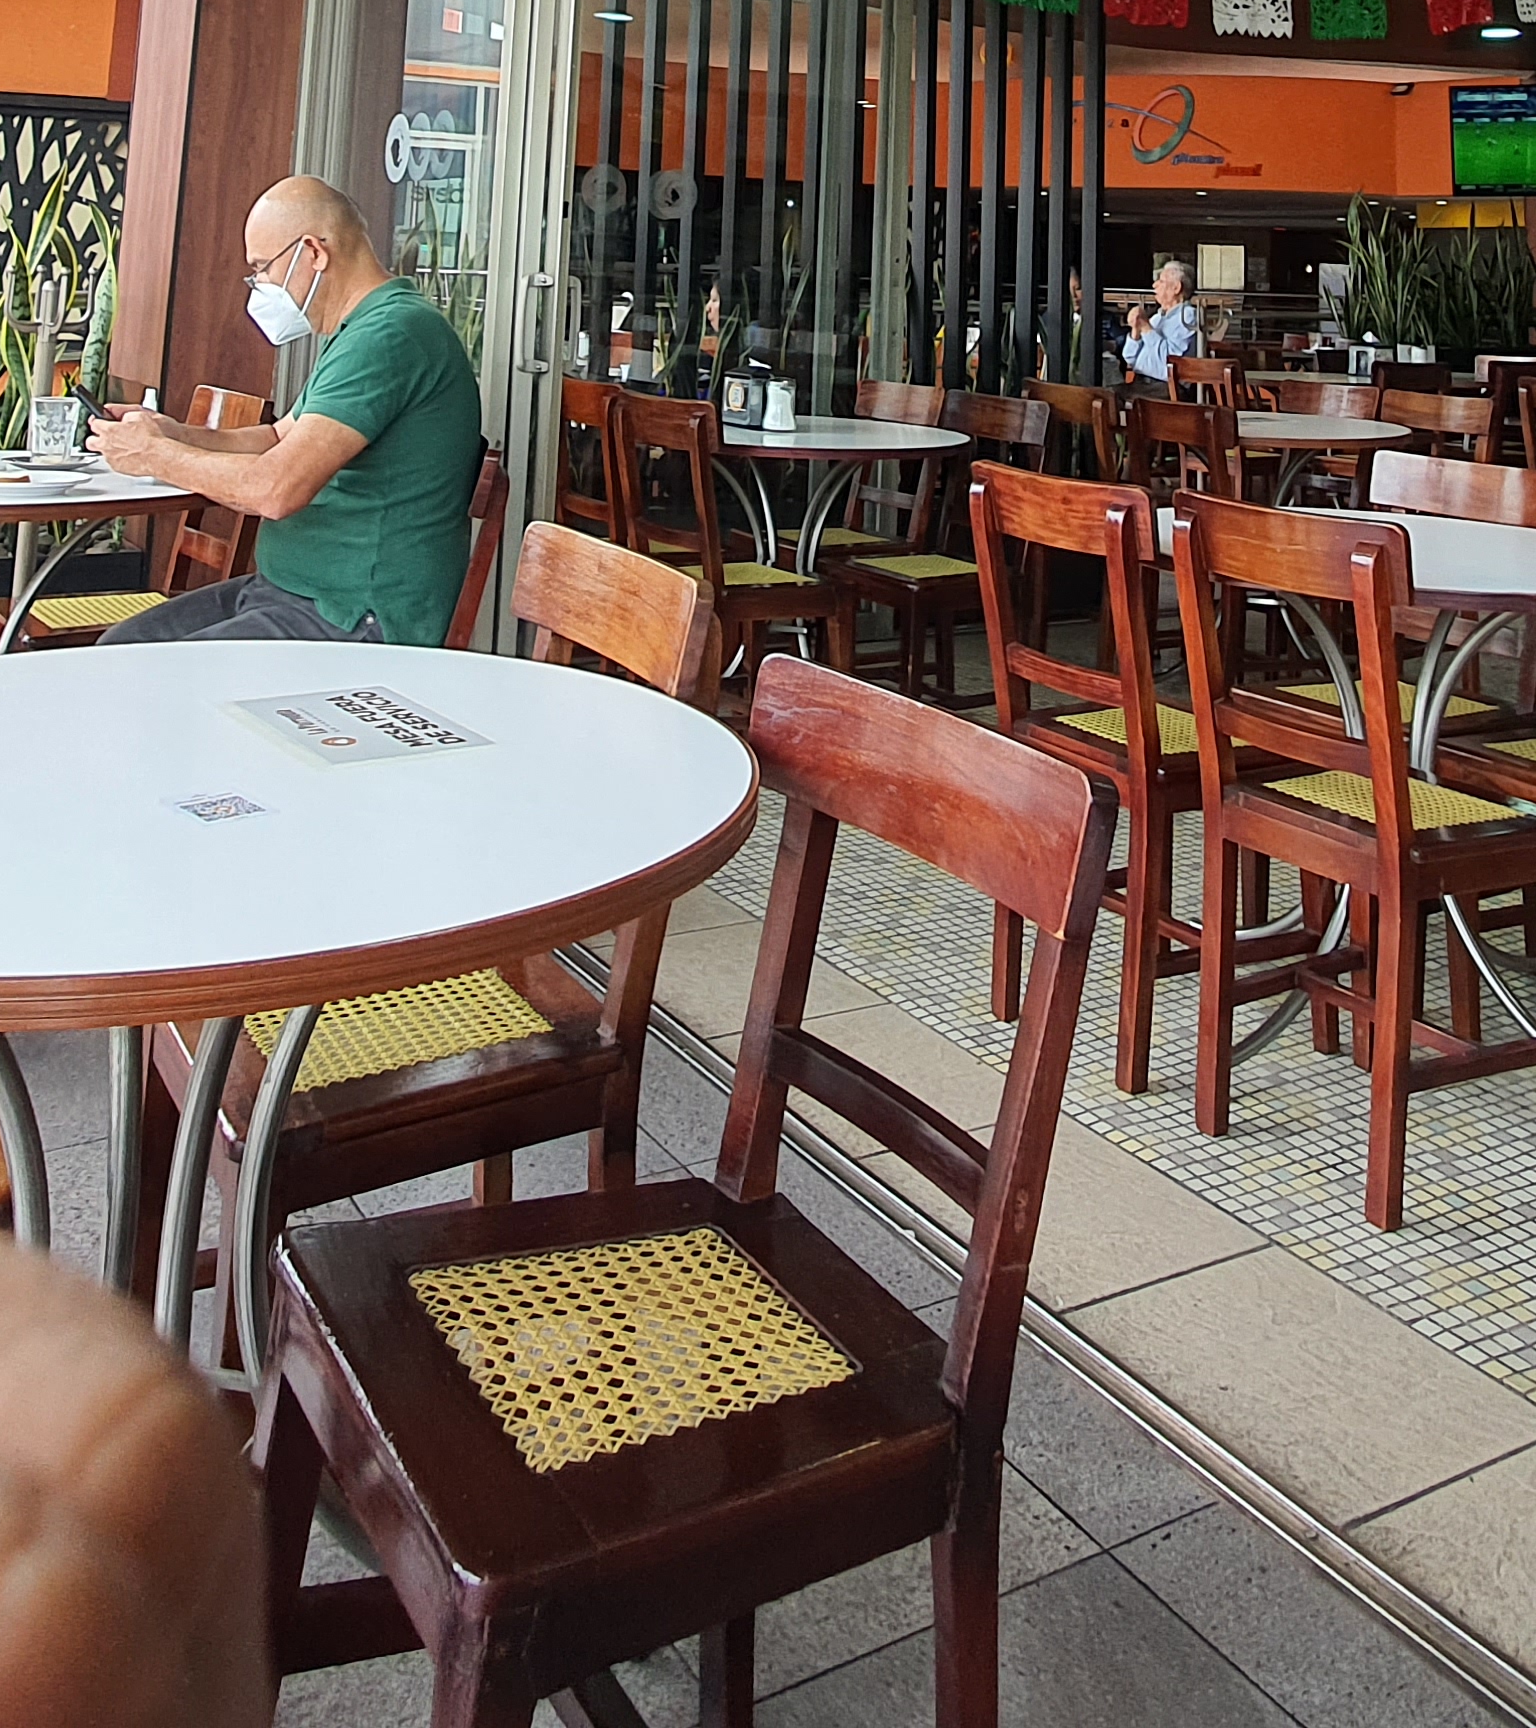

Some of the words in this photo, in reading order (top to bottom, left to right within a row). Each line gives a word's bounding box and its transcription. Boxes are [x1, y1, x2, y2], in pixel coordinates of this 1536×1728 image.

[325, 695, 388, 723] FUERA
[351, 690, 440, 731] SERVICIO
[374, 722, 434, 748] MESA
[424, 729, 468, 745] DE
